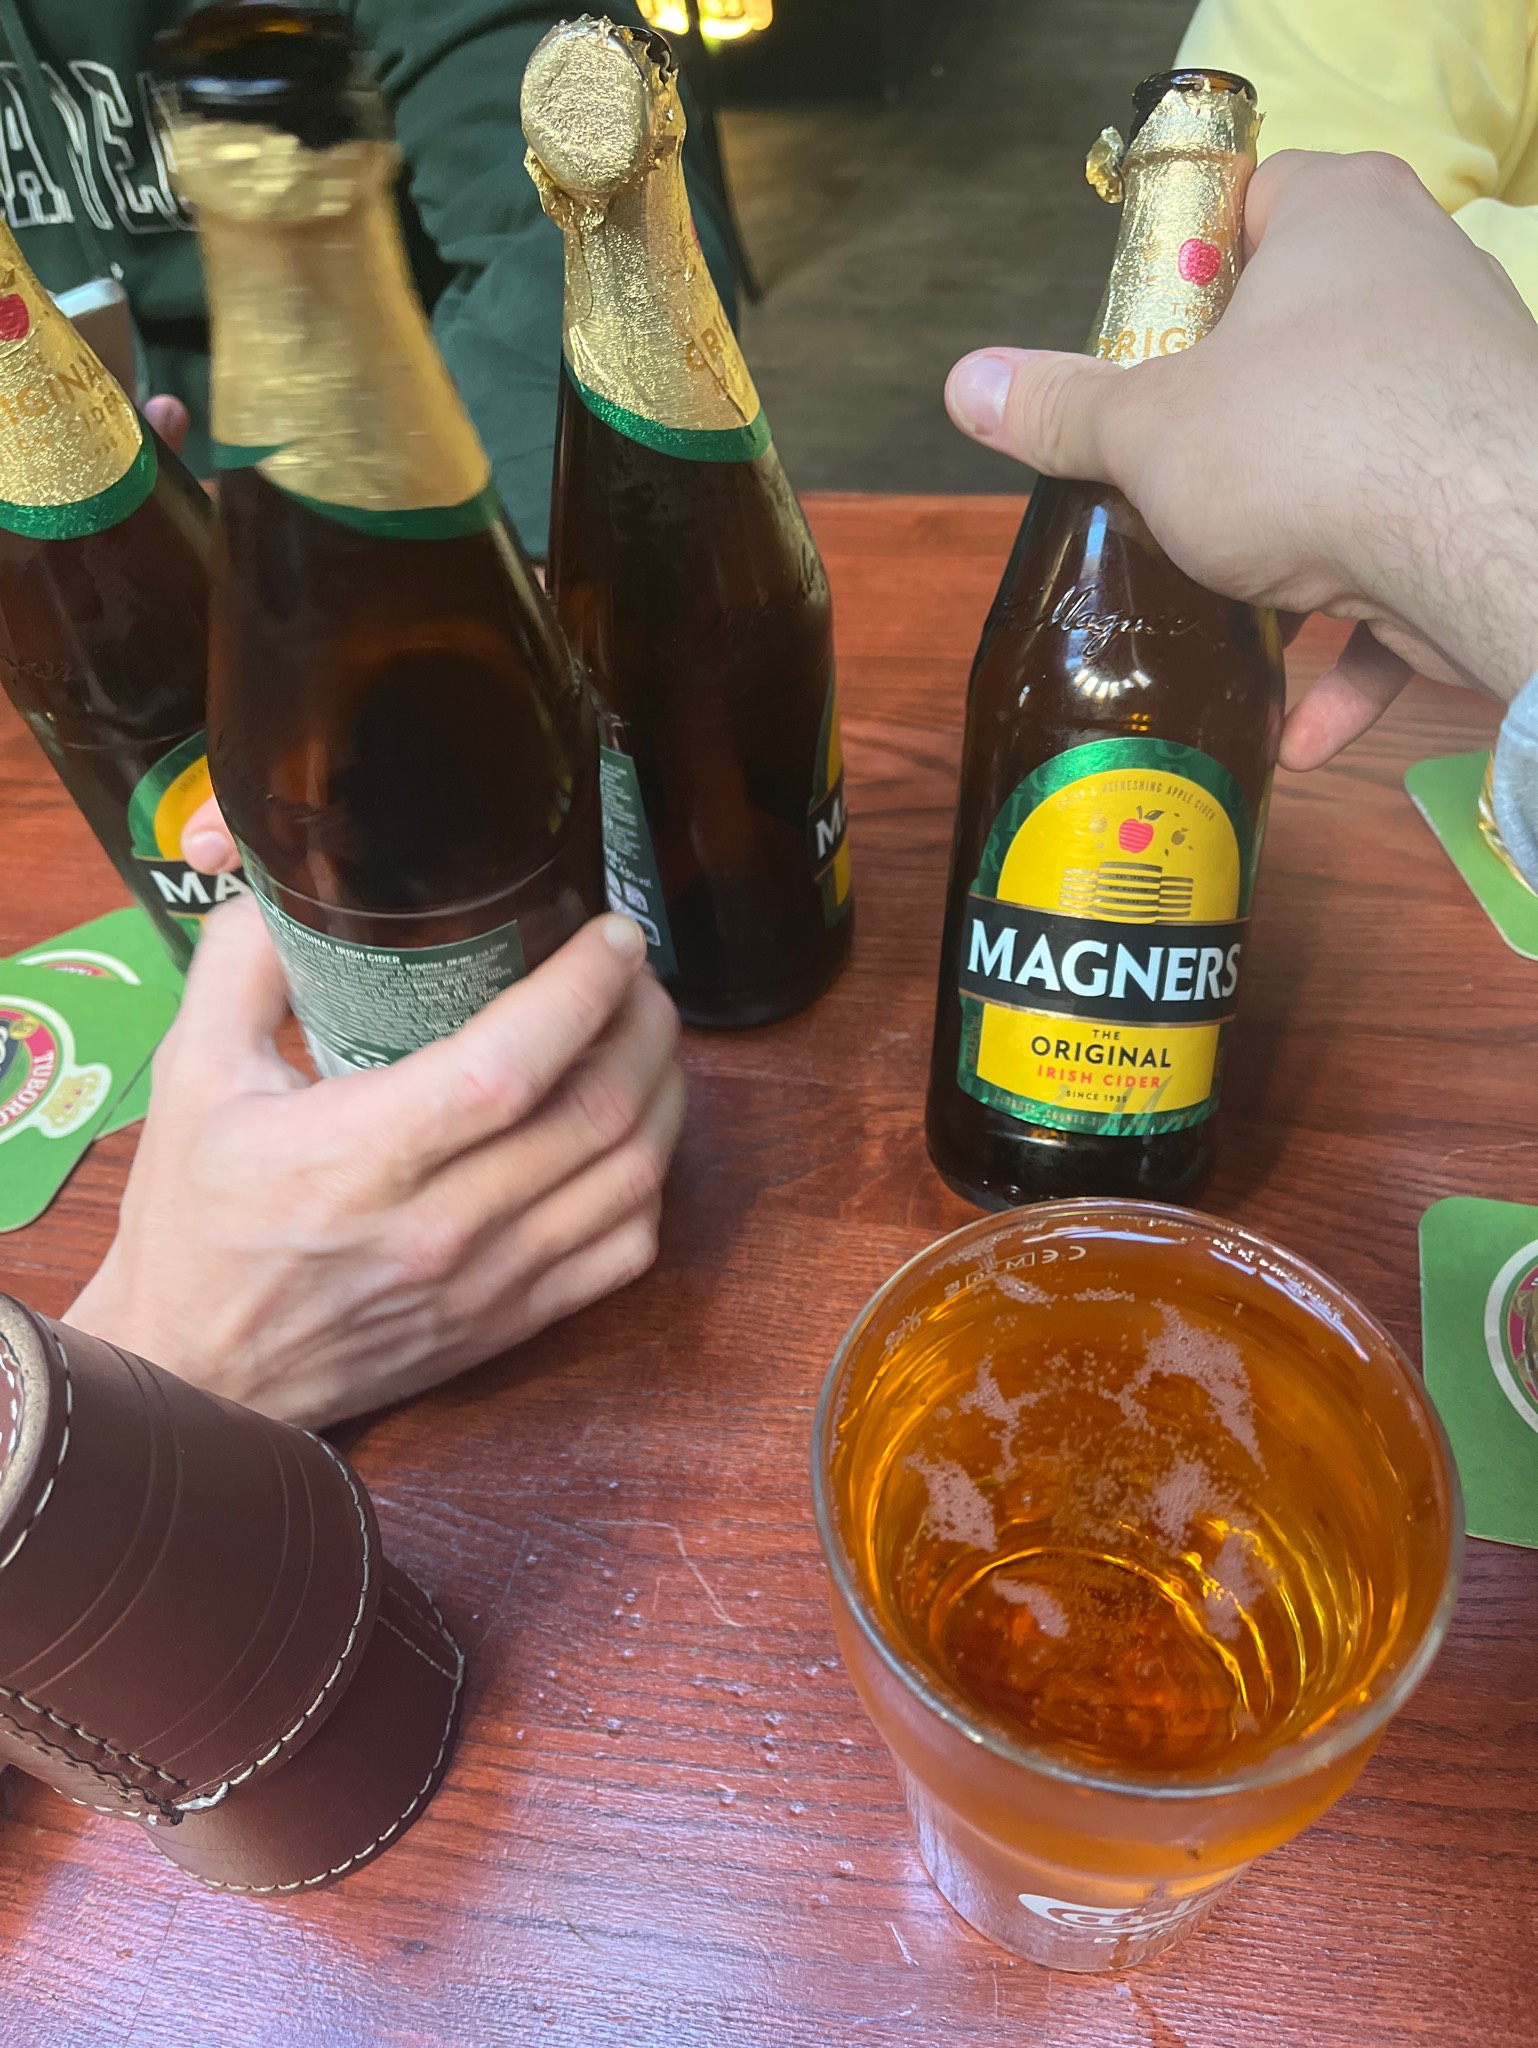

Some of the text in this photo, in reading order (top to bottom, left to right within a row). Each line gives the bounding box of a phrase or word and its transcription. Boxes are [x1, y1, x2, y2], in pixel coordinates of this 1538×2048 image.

[1101, 780, 1162, 793] REFRESHING
[1166, 785, 1194, 804] APPLE
[1194, 799, 1217, 822] CIDER
[816, 798, 846, 860] M
[151, 869, 246, 904] MA
[290, 923, 400, 964] ORIGINAL IRISH CIDER
[967, 919, 1241, 1002] MAGNERS
[1092, 1029, 1120, 1041] THE
[1031, 1036, 1171, 1068] ORIGINAL
[1038, 1065, 1160, 1088] IRISH CIDER
[1066, 1090, 1127, 1103] SINCE 1935
[1046, 1108, 1085, 1125] COUNTY
